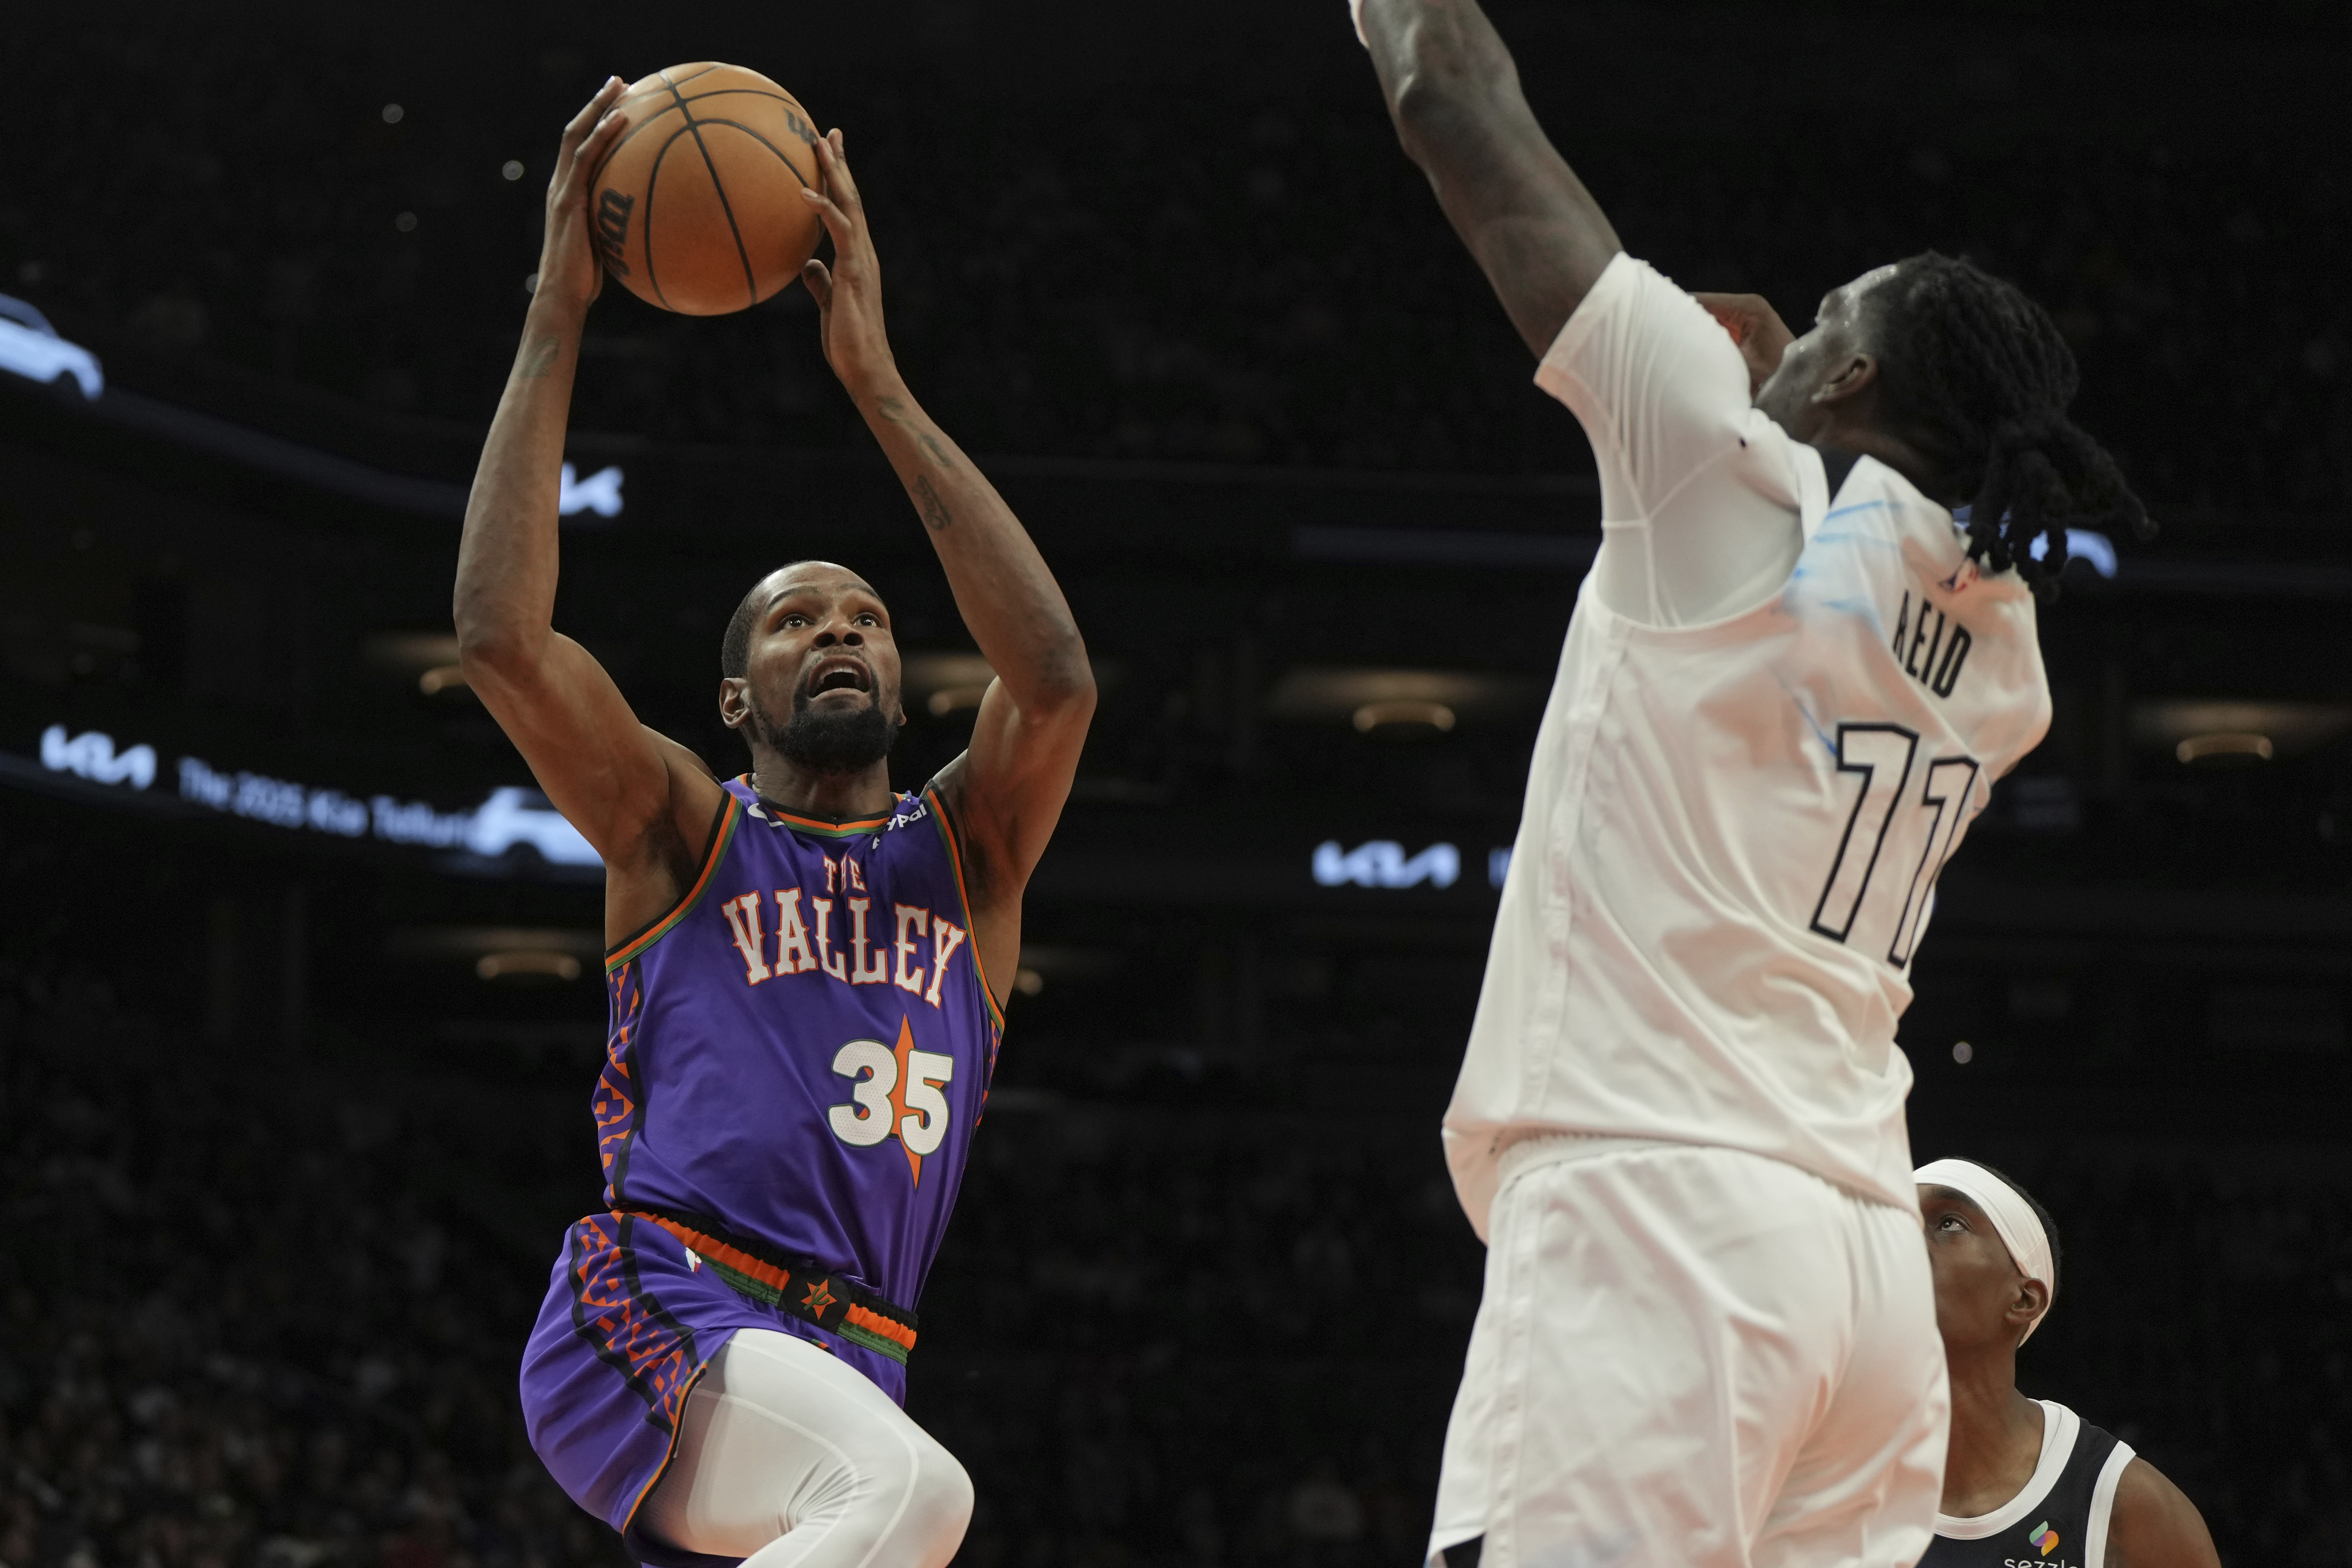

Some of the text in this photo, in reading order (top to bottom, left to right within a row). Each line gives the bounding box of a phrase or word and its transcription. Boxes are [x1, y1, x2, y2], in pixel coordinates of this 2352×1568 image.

[178, 757, 232, 812] The
[872, 803, 927, 849] PyPal
[823, 853, 867, 896] THE
[1810, 721, 1980, 970] 11
[721, 887, 967, 1009] VALLEY
[828, 1038, 954, 1156] 35
